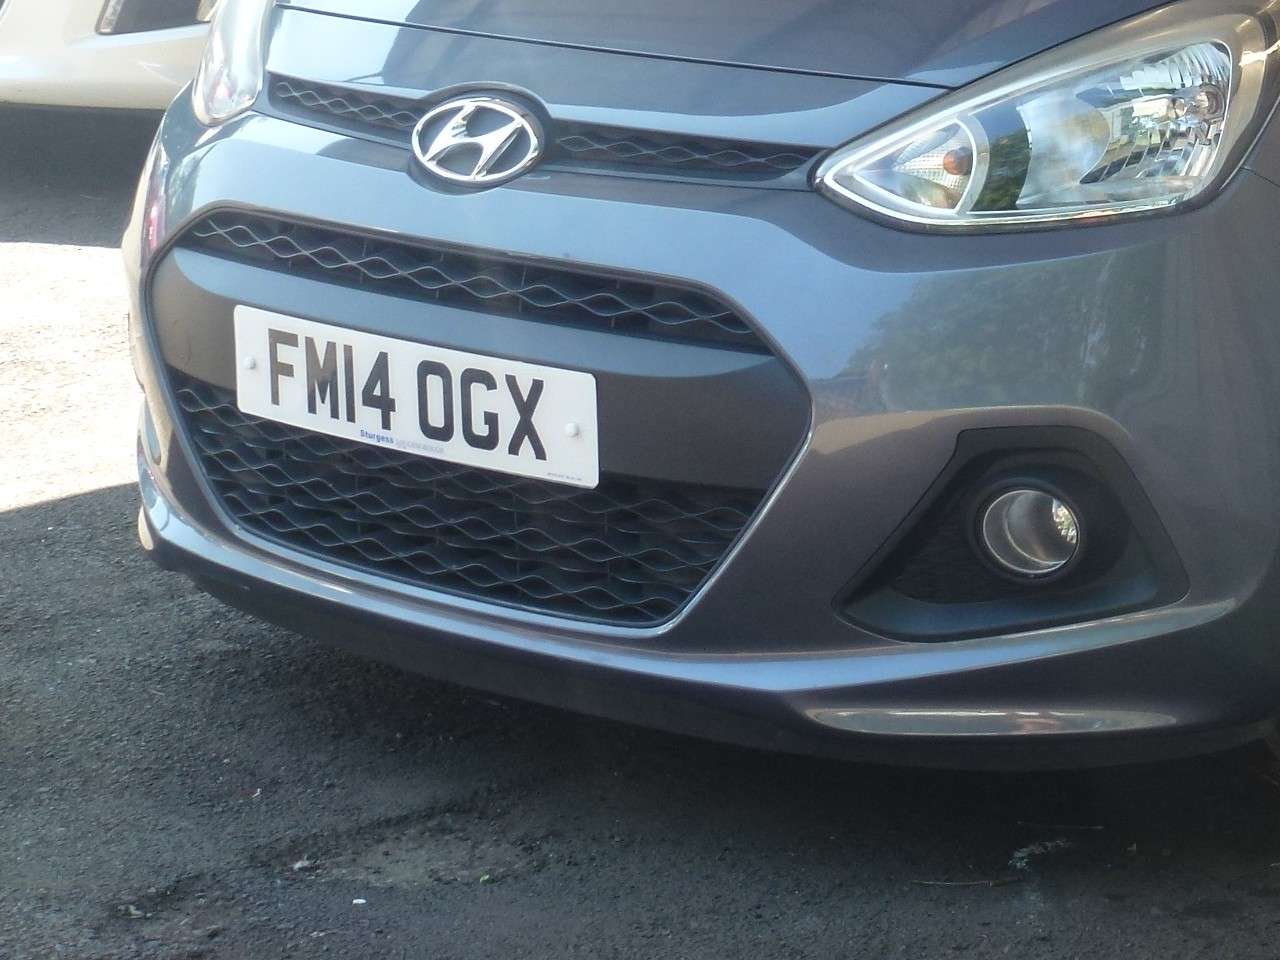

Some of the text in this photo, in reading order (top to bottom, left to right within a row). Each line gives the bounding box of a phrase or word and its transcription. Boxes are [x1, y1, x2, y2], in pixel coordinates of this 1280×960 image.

[268, 329, 547, 460] FM14 OGX
[360, 428, 394, 444] Sturgess
